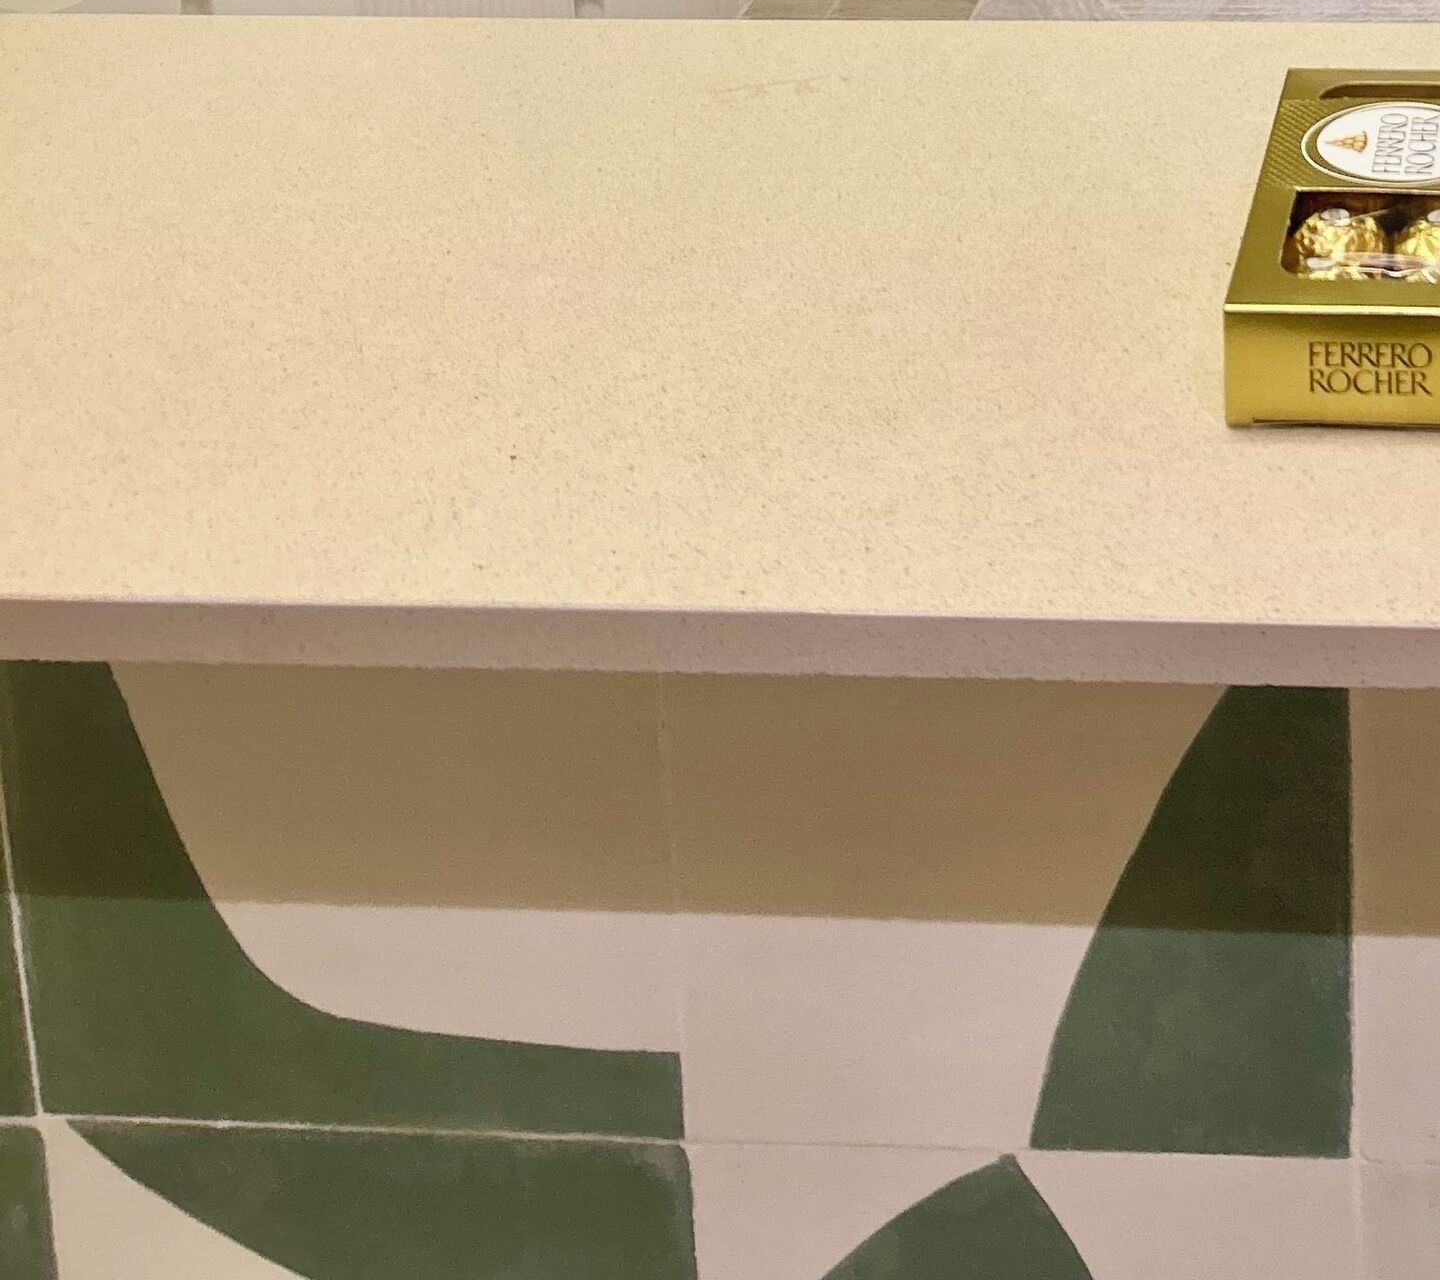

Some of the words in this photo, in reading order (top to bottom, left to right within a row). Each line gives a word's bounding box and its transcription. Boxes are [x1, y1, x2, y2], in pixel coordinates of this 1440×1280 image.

[1371, 113, 1409, 175] FERRERO
[1404, 113, 1440, 175] ROCHER
[1308, 341, 1433, 368] FERRERO
[1309, 368, 1433, 396] ROCHER
